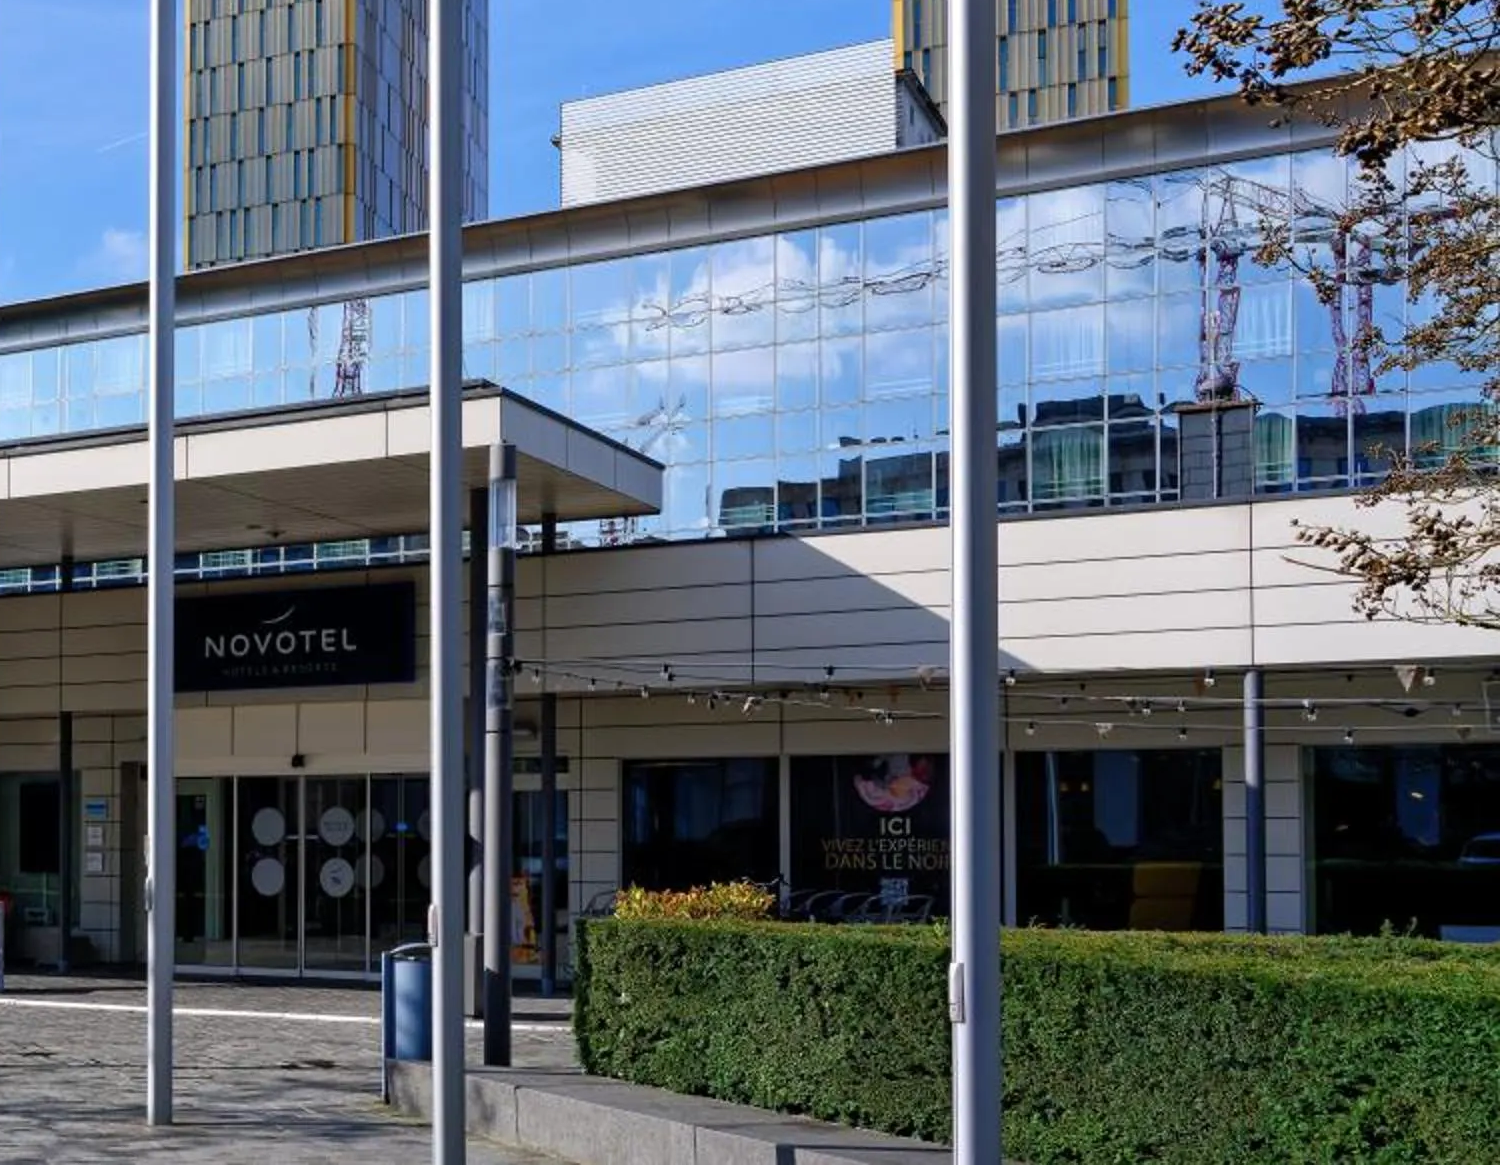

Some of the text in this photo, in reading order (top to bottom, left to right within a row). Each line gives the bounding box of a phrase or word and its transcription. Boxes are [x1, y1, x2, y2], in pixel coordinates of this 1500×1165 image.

[204, 628, 357, 658] NOVOTEL
[879, 817, 911, 835] ICI
[820, 838, 865, 852] VIVEZ
[824, 853, 877, 870] DANS
[882, 853, 903, 870] LE
